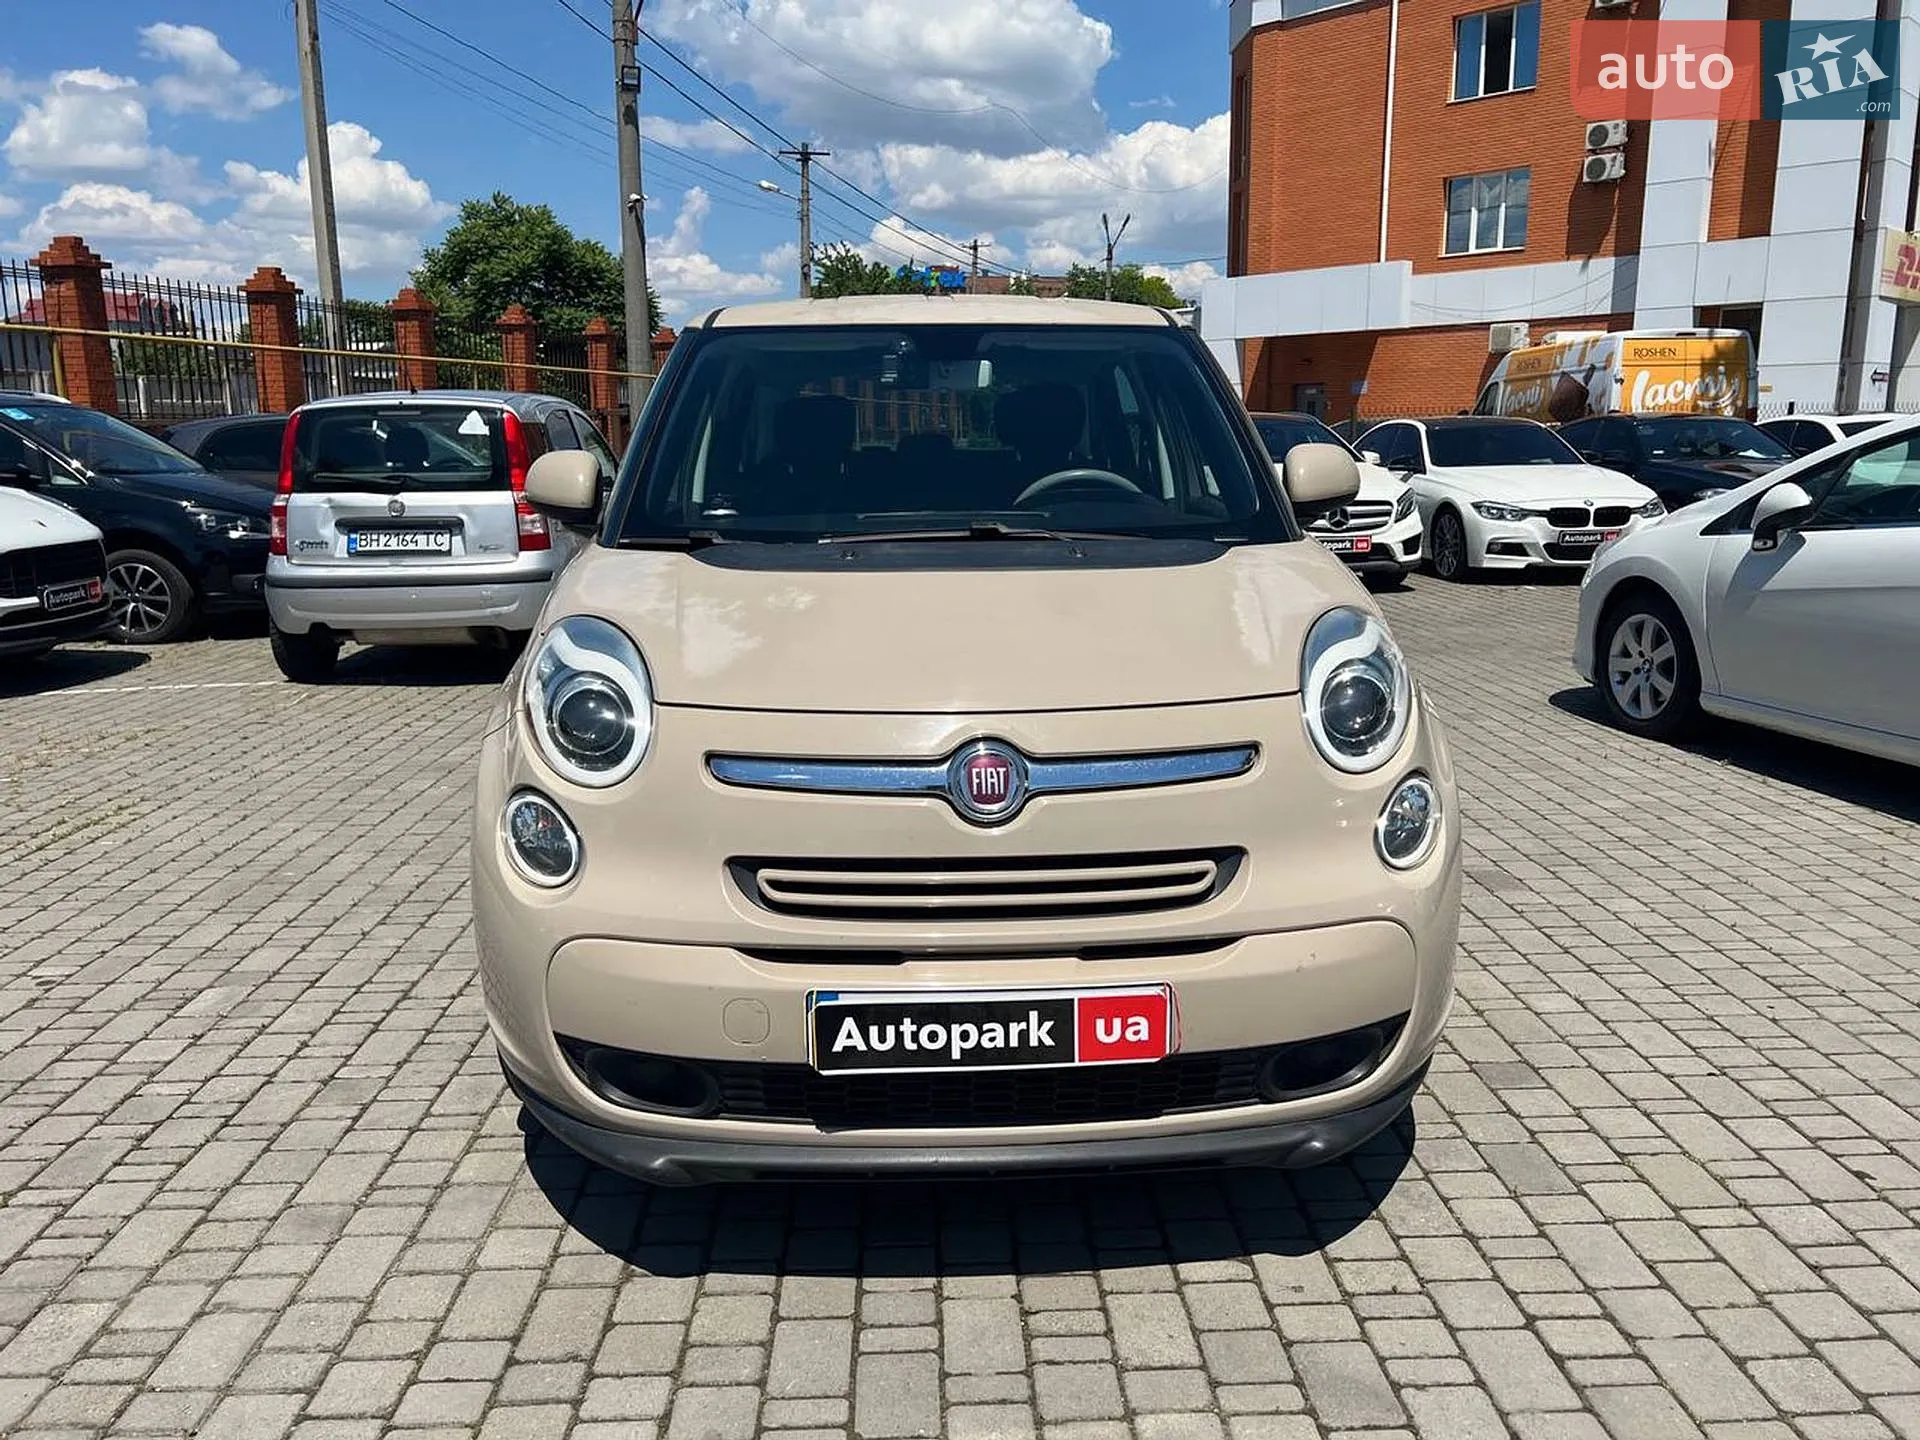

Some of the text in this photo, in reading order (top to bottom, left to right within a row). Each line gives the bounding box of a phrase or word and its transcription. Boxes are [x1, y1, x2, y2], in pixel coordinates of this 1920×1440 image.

[1633, 347, 1677, 359] ROSHEN
[358, 532, 380, 548] BH
[384, 532, 418, 547] 2164
[423, 532, 444, 547] TC
[1564, 534, 1602, 544] Autopark
[49, 586, 86, 607] Autopark
[971, 767, 1007, 795] FIAT
[830, 1010, 1150, 1060] Autopark ua
